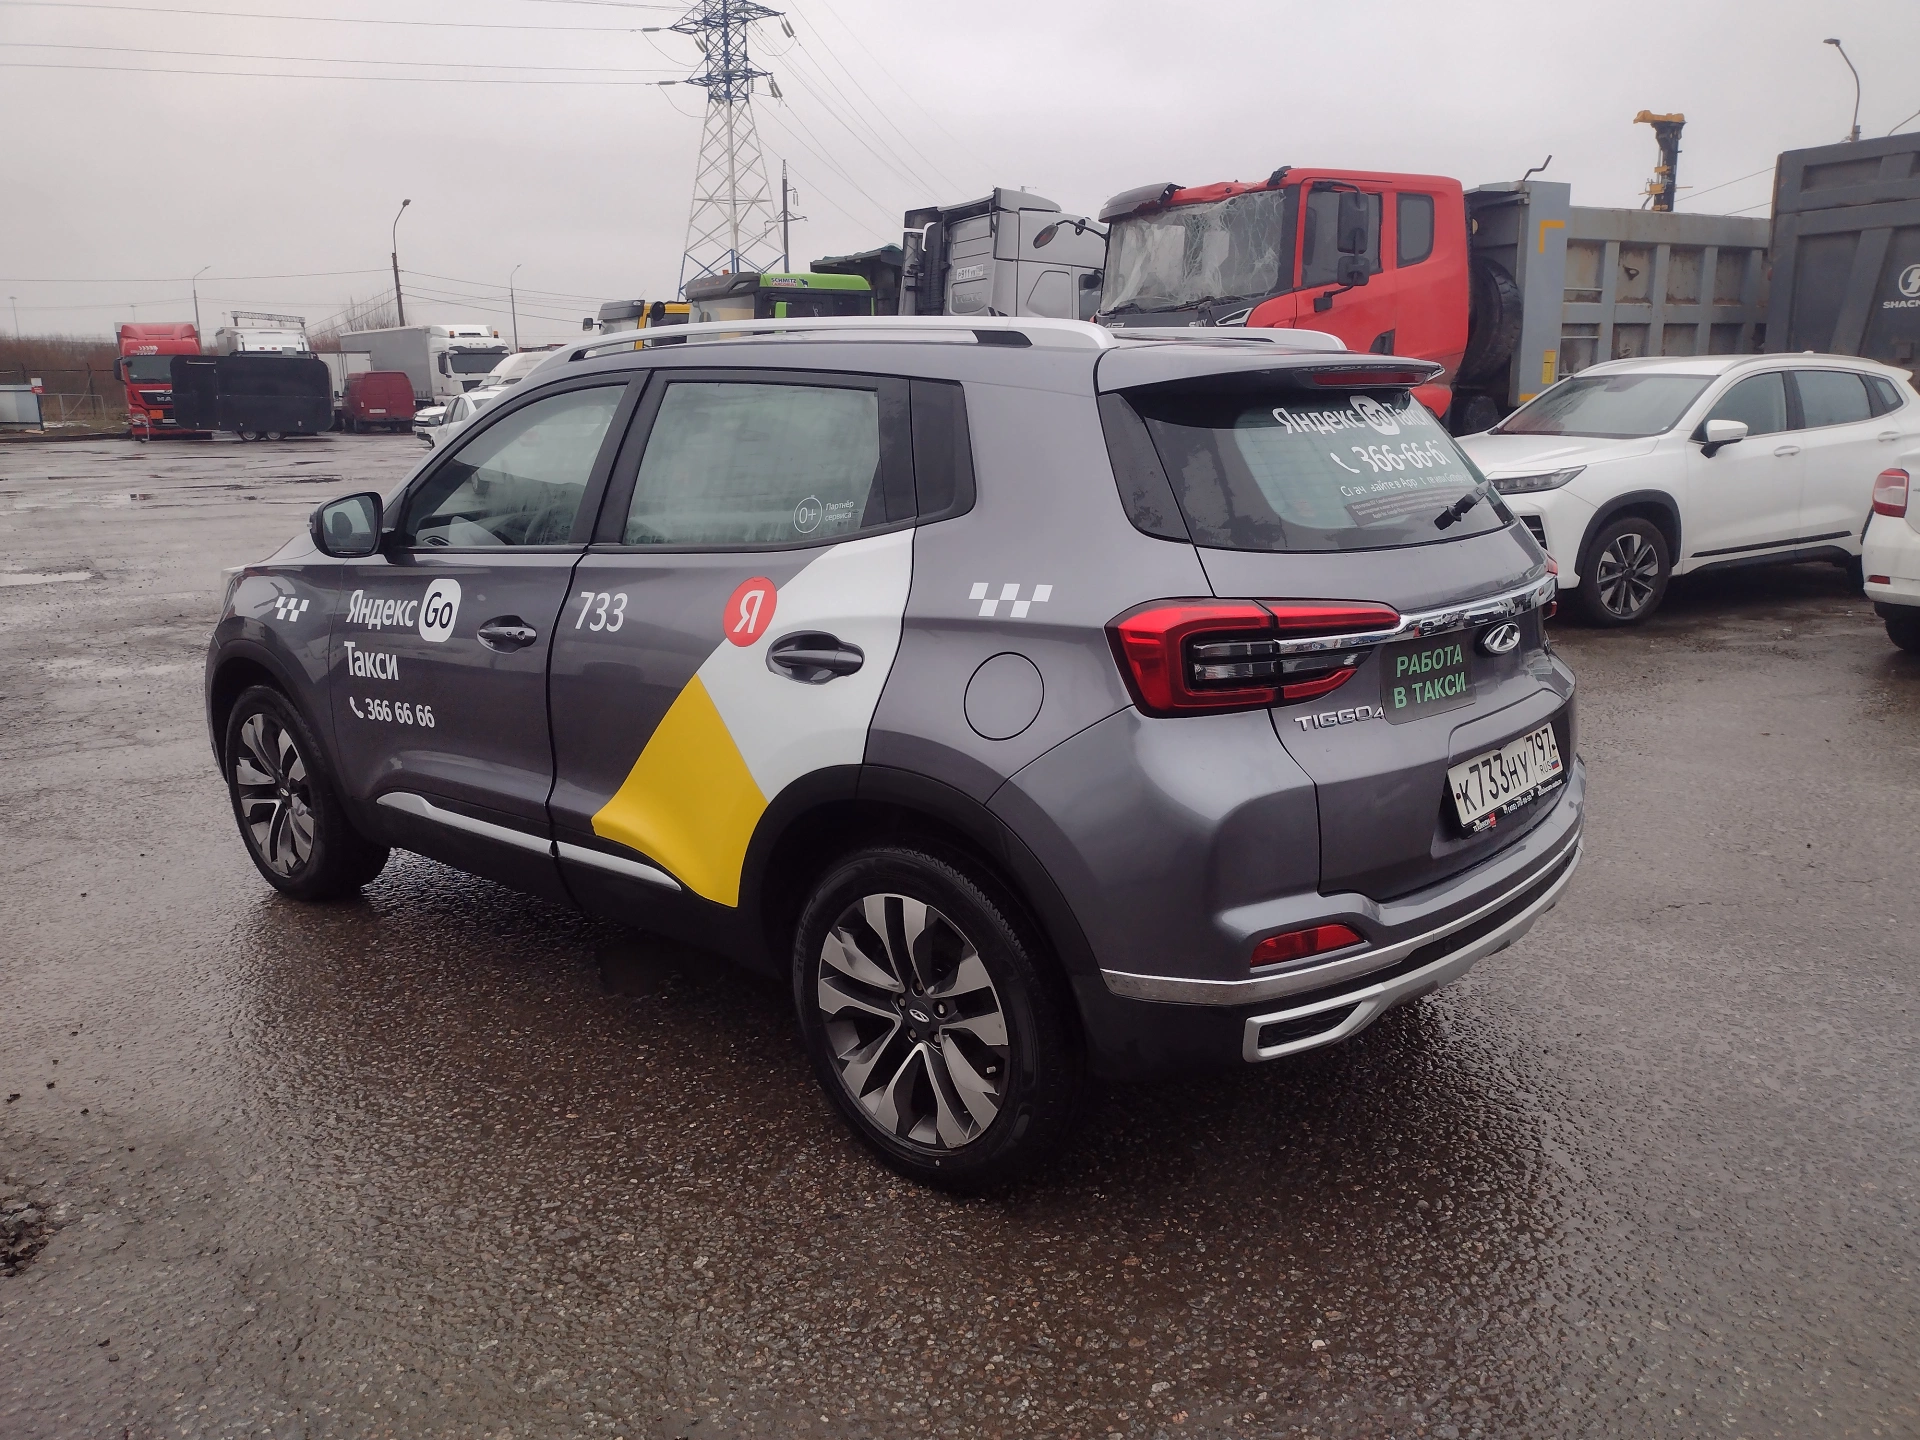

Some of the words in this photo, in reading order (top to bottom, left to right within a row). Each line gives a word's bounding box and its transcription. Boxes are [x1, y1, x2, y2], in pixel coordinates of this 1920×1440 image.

[1272, 408, 1366, 435] Яндекс
[1357, 403, 1394, 427] Go
[1382, 402, 1431, 426] Такси
[1401, 478, 1417, 489] App
[799, 507, 817, 523] 0+
[825, 500, 855, 512] Партнёр
[825, 512, 852, 522] сервиса
[345, 589, 418, 630] Яндекс
[424, 592, 453, 629] Go
[574, 591, 628, 633] 733
[733, 590, 765, 634] Я
[344, 641, 399, 681] Такси
[1396, 644, 1463, 678] РАБОТА
[1393, 686, 1407, 709] В
[1411, 671, 1466, 704] ТАКСИ
[365, 698, 393, 722] 366
[394, 701, 414, 725] 66
[416, 704, 435, 728] 66
[1525, 728, 1552, 767] 797
[1540, 760, 1552, 775] RUS
